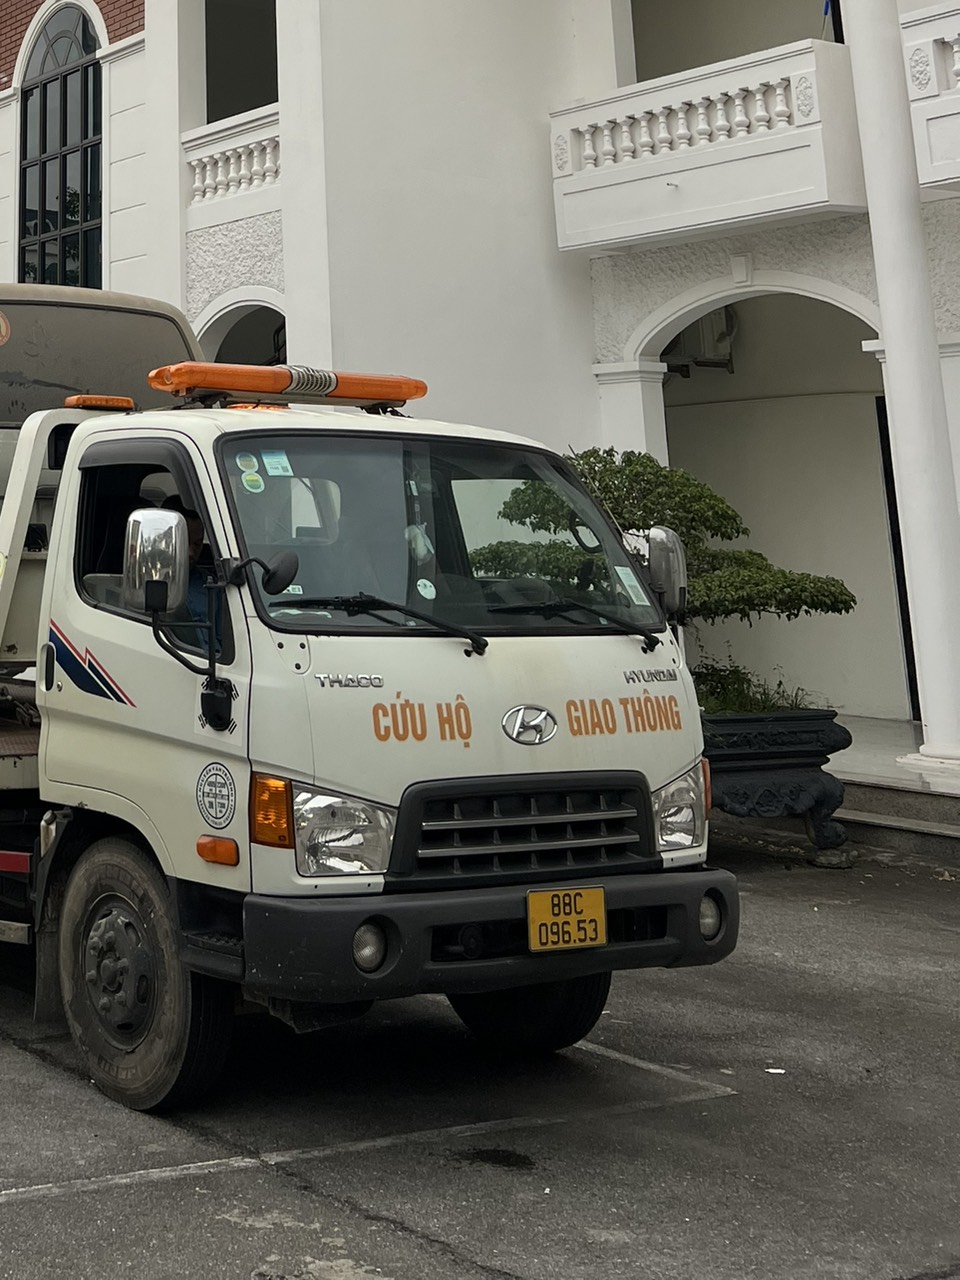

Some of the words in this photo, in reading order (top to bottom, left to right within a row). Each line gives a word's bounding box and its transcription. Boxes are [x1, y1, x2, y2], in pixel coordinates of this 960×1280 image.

[314, 673, 384, 688] THACO
[623, 669, 678, 684] HYUNDAI
[372, 691, 428, 742] CỨU
[436, 694, 473, 748] HỘ
[565, 698, 618, 737] GIAO
[618, 688, 682, 734] THÔNG
[551, 892, 584, 917] 88C
[538, 918, 599, 946] 096.53
